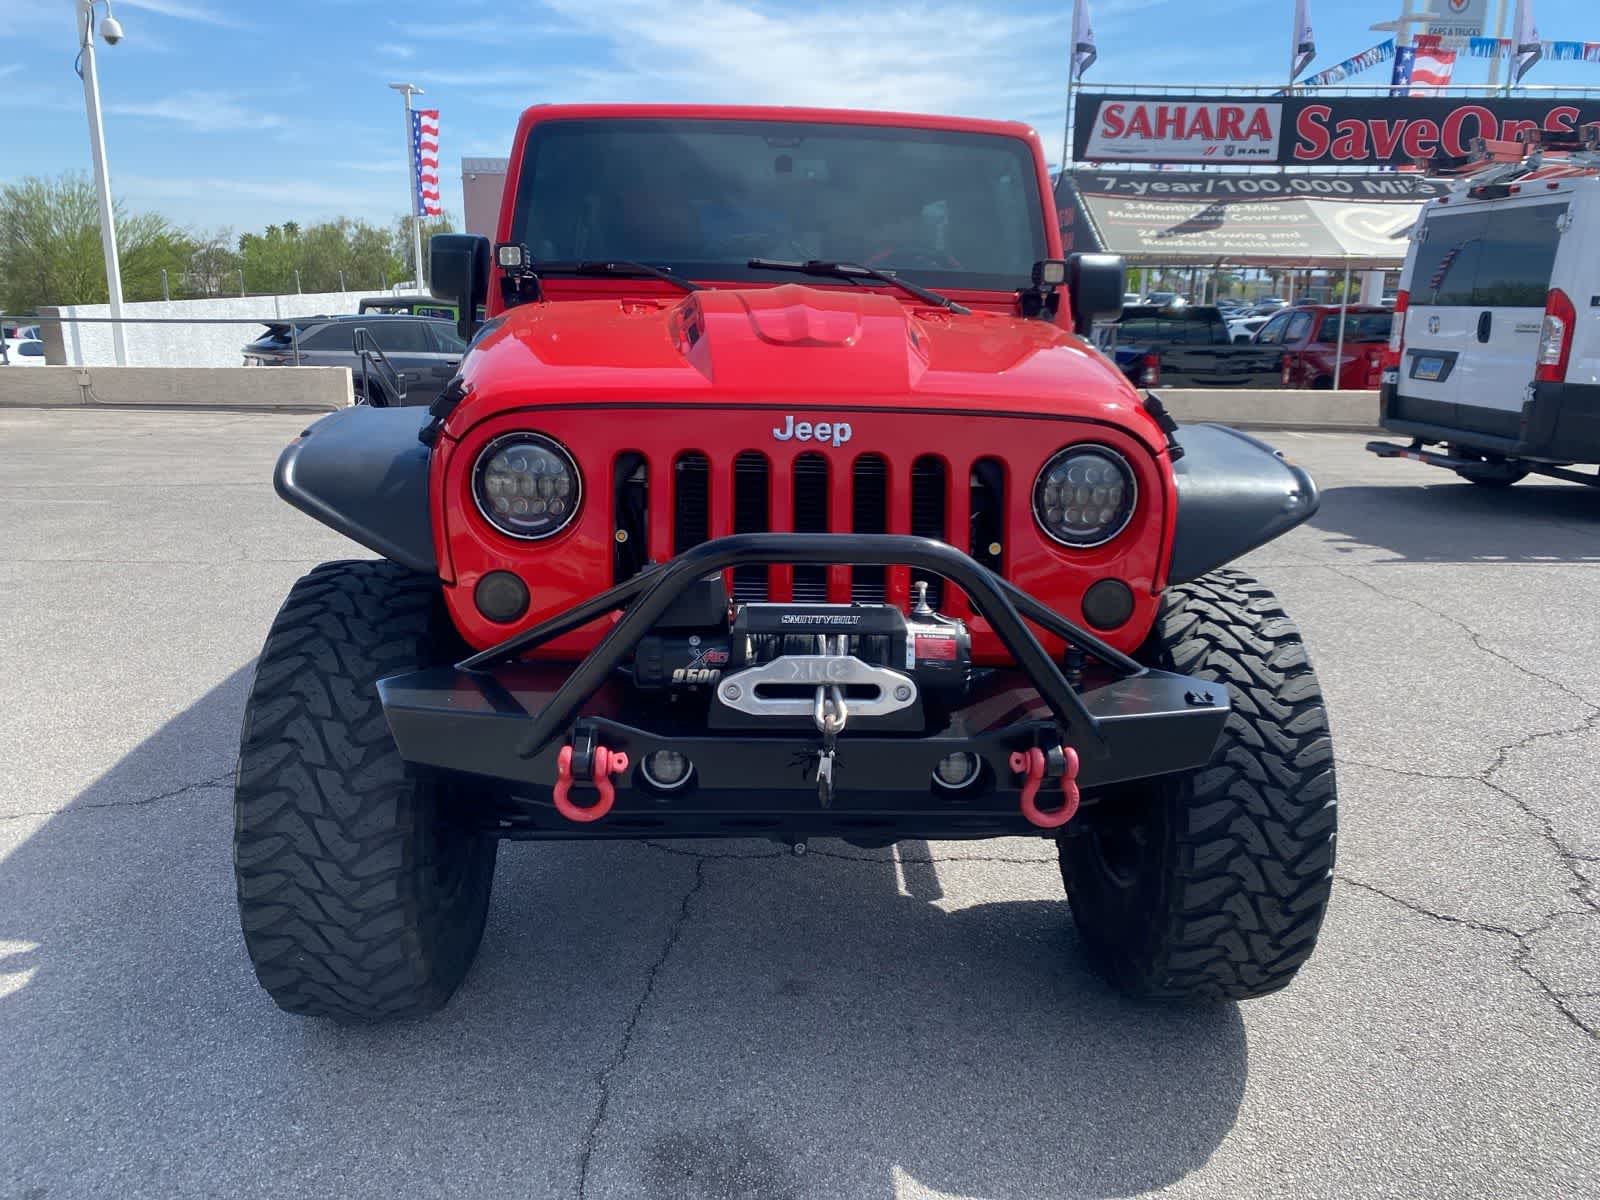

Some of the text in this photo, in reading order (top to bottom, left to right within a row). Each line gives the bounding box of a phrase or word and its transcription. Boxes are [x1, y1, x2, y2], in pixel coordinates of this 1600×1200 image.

[1101, 104, 1273, 141] SAHARA
[1237, 147, 1270, 155] RAM
[1096, 177, 1354, 196] 7-year/100,000
[772, 415, 852, 448] Jeep
[781, 615, 861, 625] SMITTYBILT
